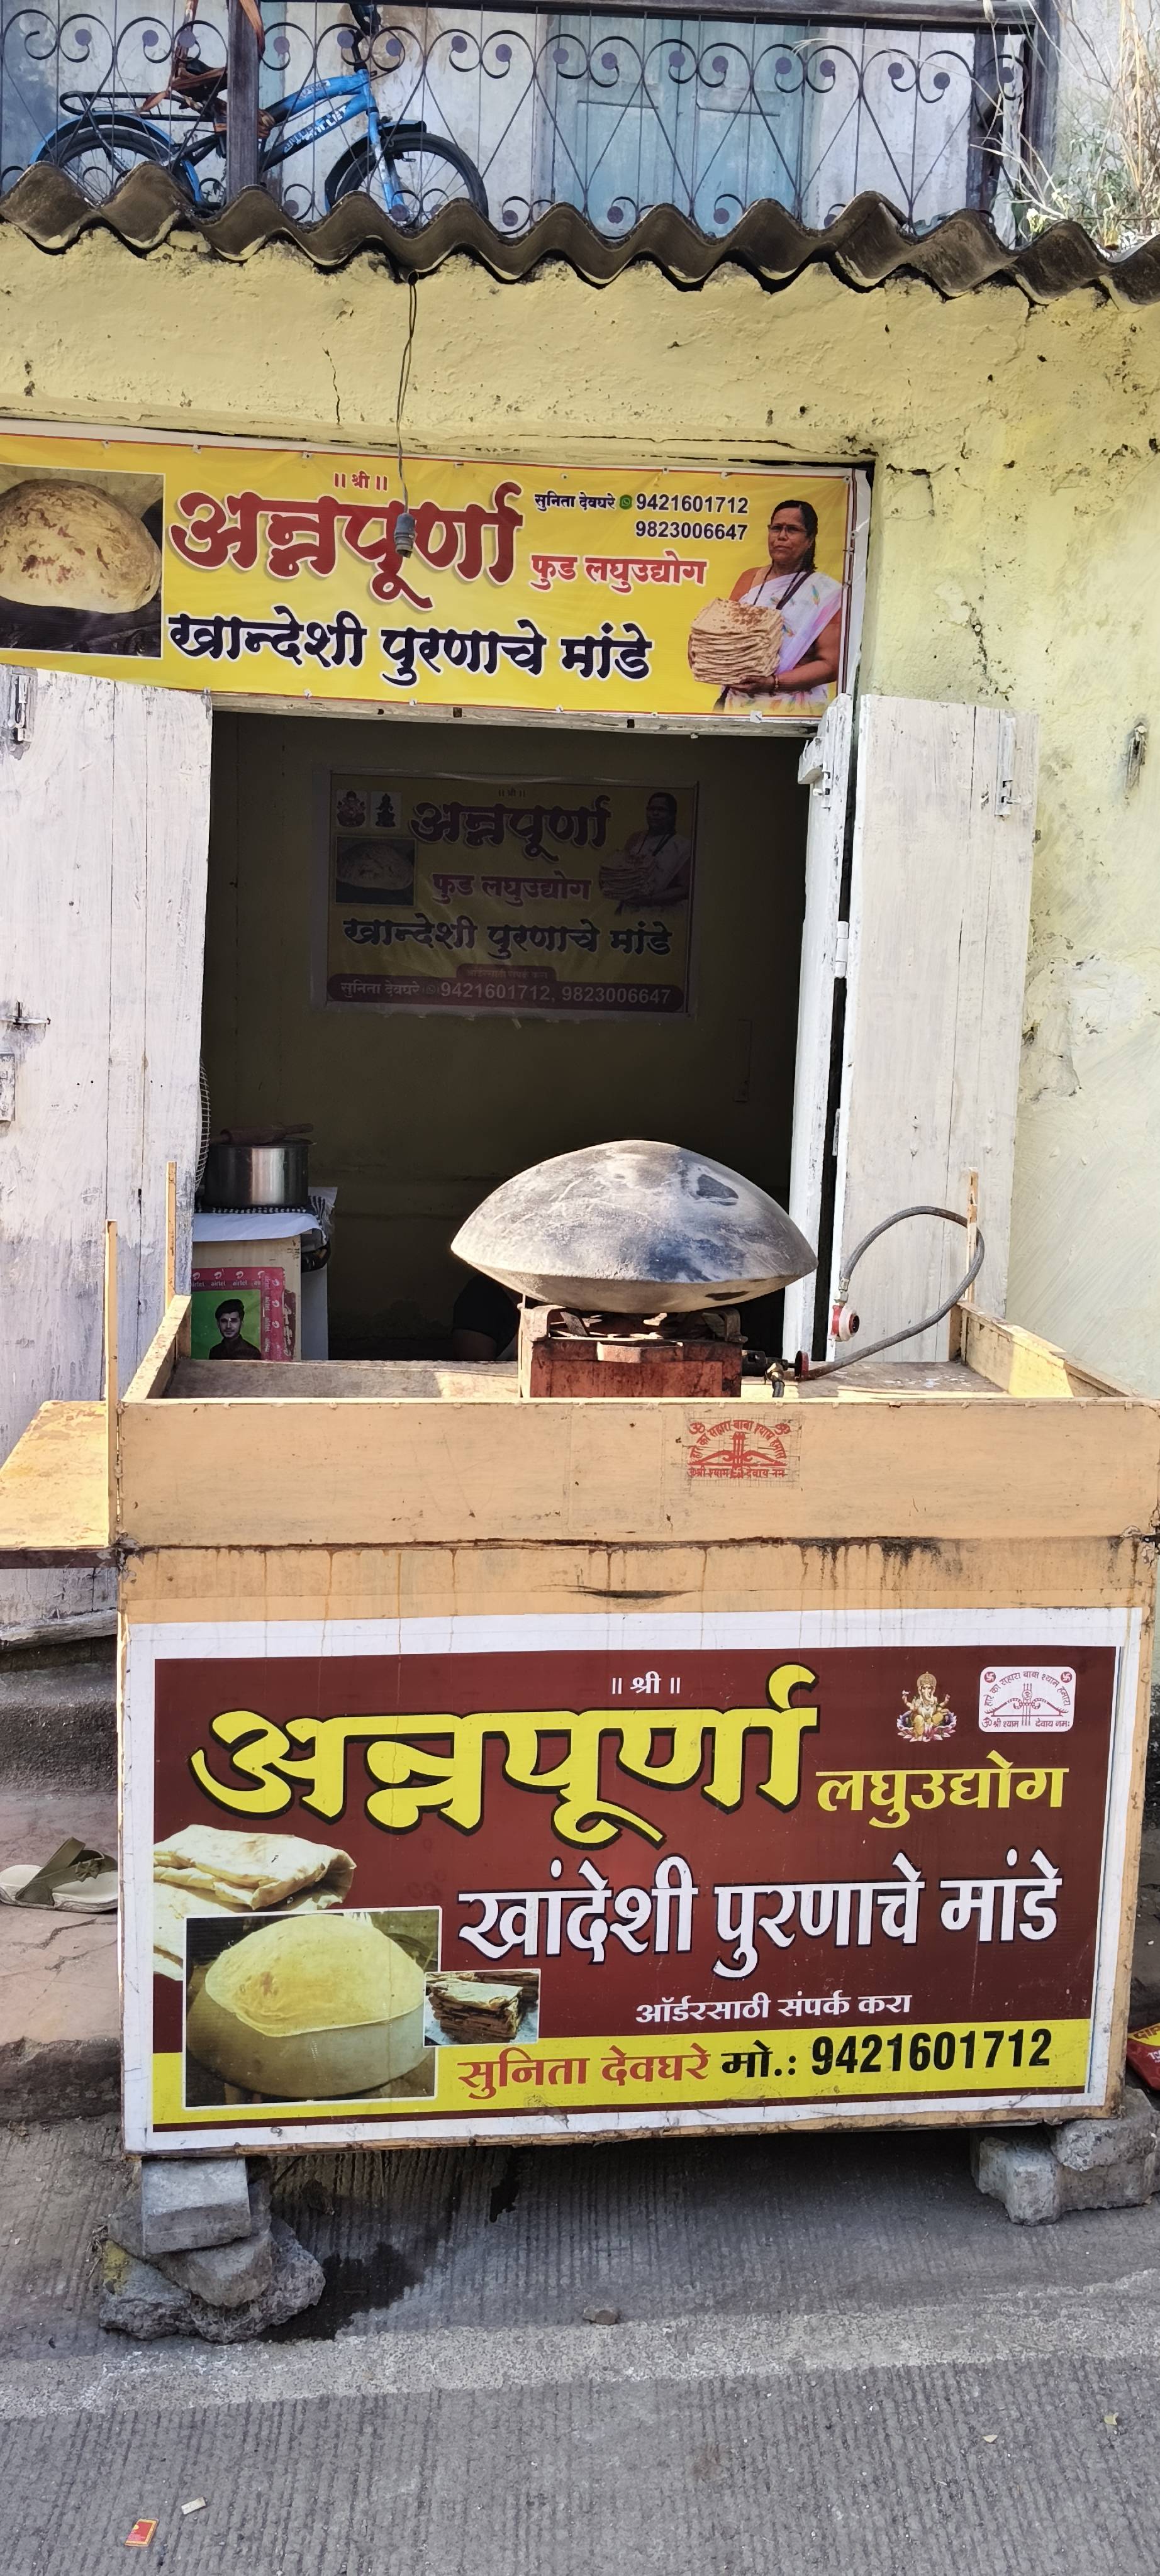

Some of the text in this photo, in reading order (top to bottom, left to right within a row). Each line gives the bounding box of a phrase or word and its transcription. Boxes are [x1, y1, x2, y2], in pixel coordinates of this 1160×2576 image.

[352, 472, 369, 491] श्री
[535, 491, 749, 514] सुनिता देवघरे 9421601712
[170, 482, 523, 609] अन्नपूर्णा
[635, 521, 748, 540] 9823006647
[530, 550, 707, 593] फुड लघुउद्योग
[169, 606, 652, 686] खान्देशी पुरणाचे मांडे
[409, 796, 611, 861] अन्नपूर्णा
[433, 871, 591, 906] फुड लघुउद्योग
[343, 913, 672, 958] खान्देशी पुरणाचे मांडे
[340, 981, 381, 998] सुनिता
[440, 982, 555, 1002] 9421601712,
[562, 987, 671, 1005] 9823006647
[732, 1419, 754, 1431] बाबा
[630, 1670, 661, 1694] श्री
[990, 1684, 1001, 1694] का
[999, 1672, 1021, 1685] सहारा
[1041, 1674, 1060, 1688] श्याम
[1057, 1685, 1071, 1706] हमारा
[1035, 1718, 1054, 1728] देवाय
[191, 1664, 818, 1847] अन्नपूर्णा
[815, 1750, 1069, 1828] लघुउद्योग
[458, 1848, 1062, 1979] खांदेशी पुरणाचे मांडे
[635, 1989, 913, 2023] ऑर्डरसाठी संपर्क करा
[457, 2046, 590, 2100] सुनिता
[600, 2043, 711, 2086] देवघरे
[811, 2028, 1052, 2075] 9421601712
